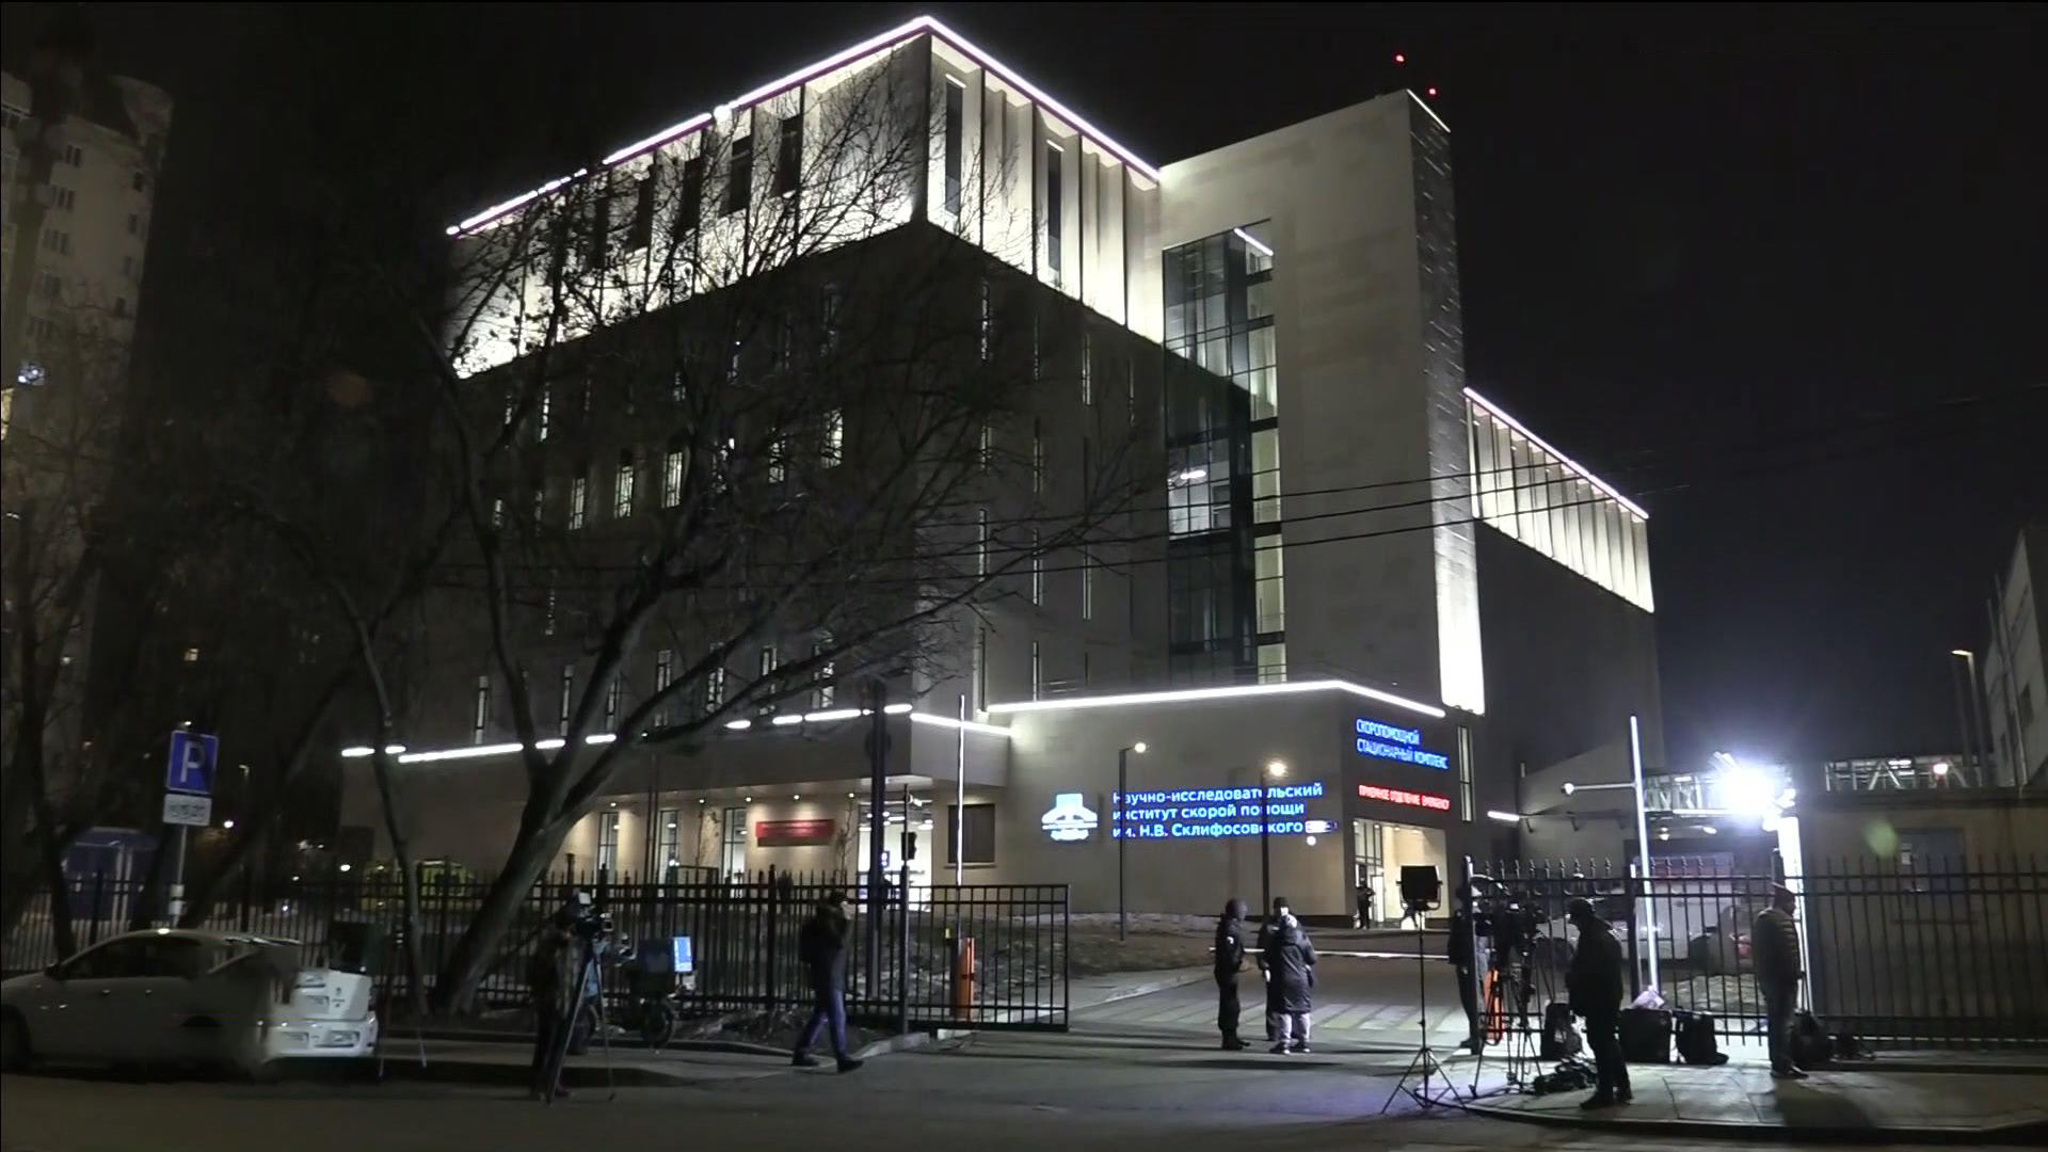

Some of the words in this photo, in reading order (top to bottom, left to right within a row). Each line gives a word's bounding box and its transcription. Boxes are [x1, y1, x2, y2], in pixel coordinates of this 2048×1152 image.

[180, 741, 206, 782] P
[1181, 803, 1237, 820] скорой
[1139, 824, 1169, 837] Н.В.
